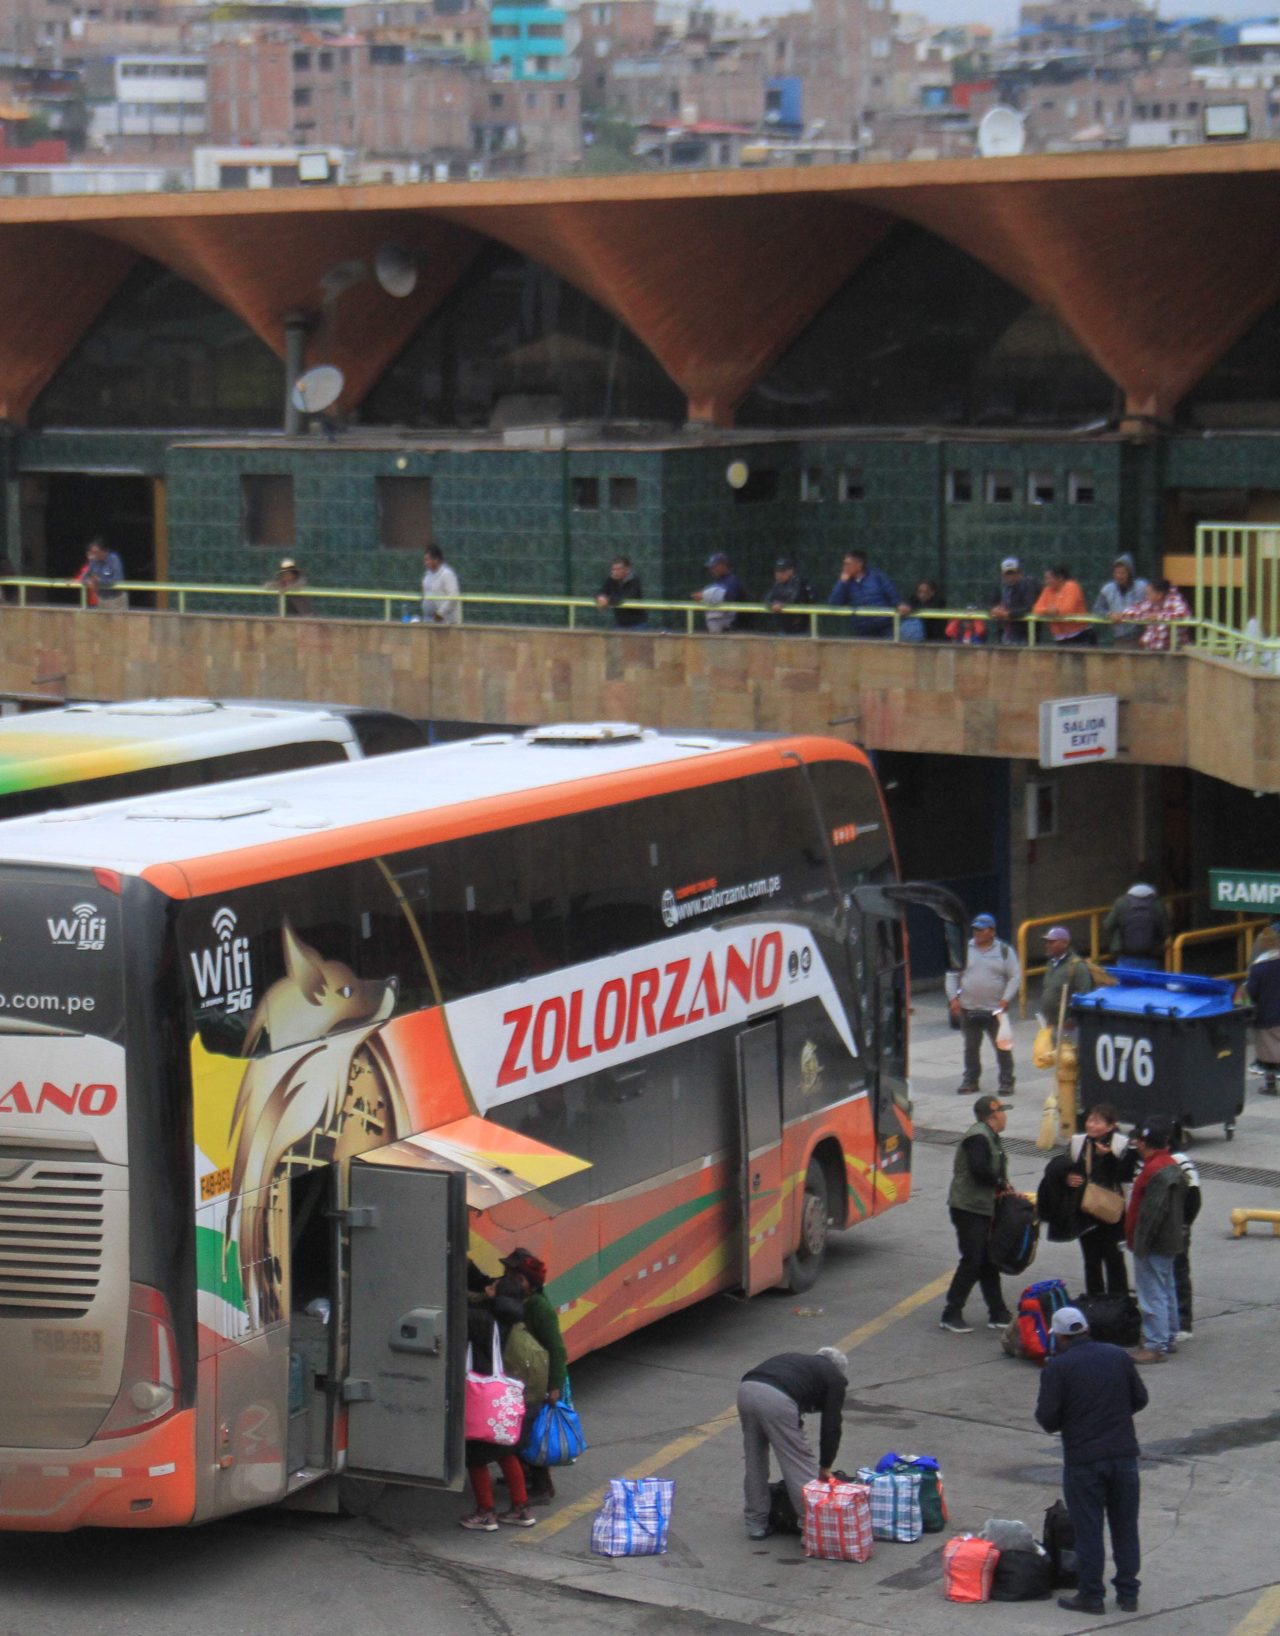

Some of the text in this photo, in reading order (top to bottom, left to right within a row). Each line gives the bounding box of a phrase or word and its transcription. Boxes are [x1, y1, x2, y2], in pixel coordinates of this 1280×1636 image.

[1063, 718, 1106, 734] SALIDA
[1071, 733, 1098, 746] EXIT
[677, 874, 781, 920] www.zolorzano.com.pe
[47, 918, 107, 941] Wifi
[76, 940, 106, 951] 5G
[190, 937, 252, 998] Wifi
[225, 988, 252, 1014] 5G
[496, 930, 783, 1087] ZOLORZANO
[1096, 1034, 1155, 1087] 076
